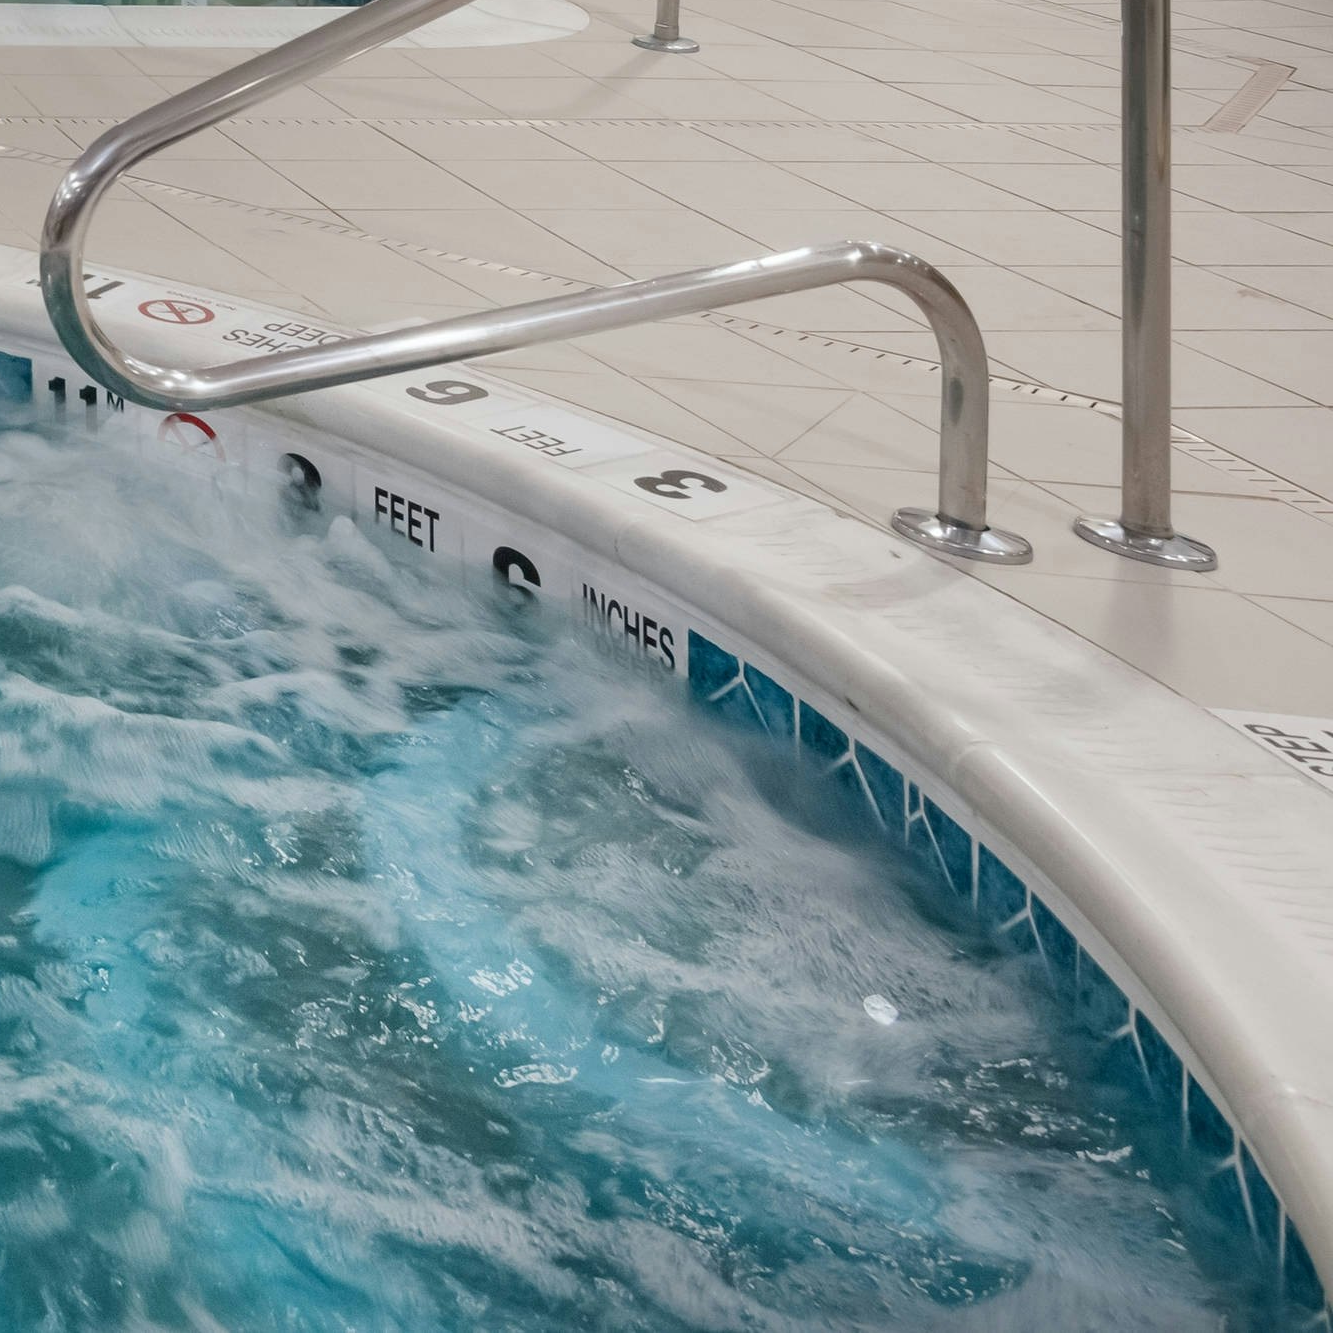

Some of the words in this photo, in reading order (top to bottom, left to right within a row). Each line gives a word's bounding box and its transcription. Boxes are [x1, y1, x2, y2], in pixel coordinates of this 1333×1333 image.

[489, 425, 583, 457] FEET
[633, 469, 728, 500] 3
[375, 486, 440, 553] FEET
[582, 583, 676, 674] INCHES
